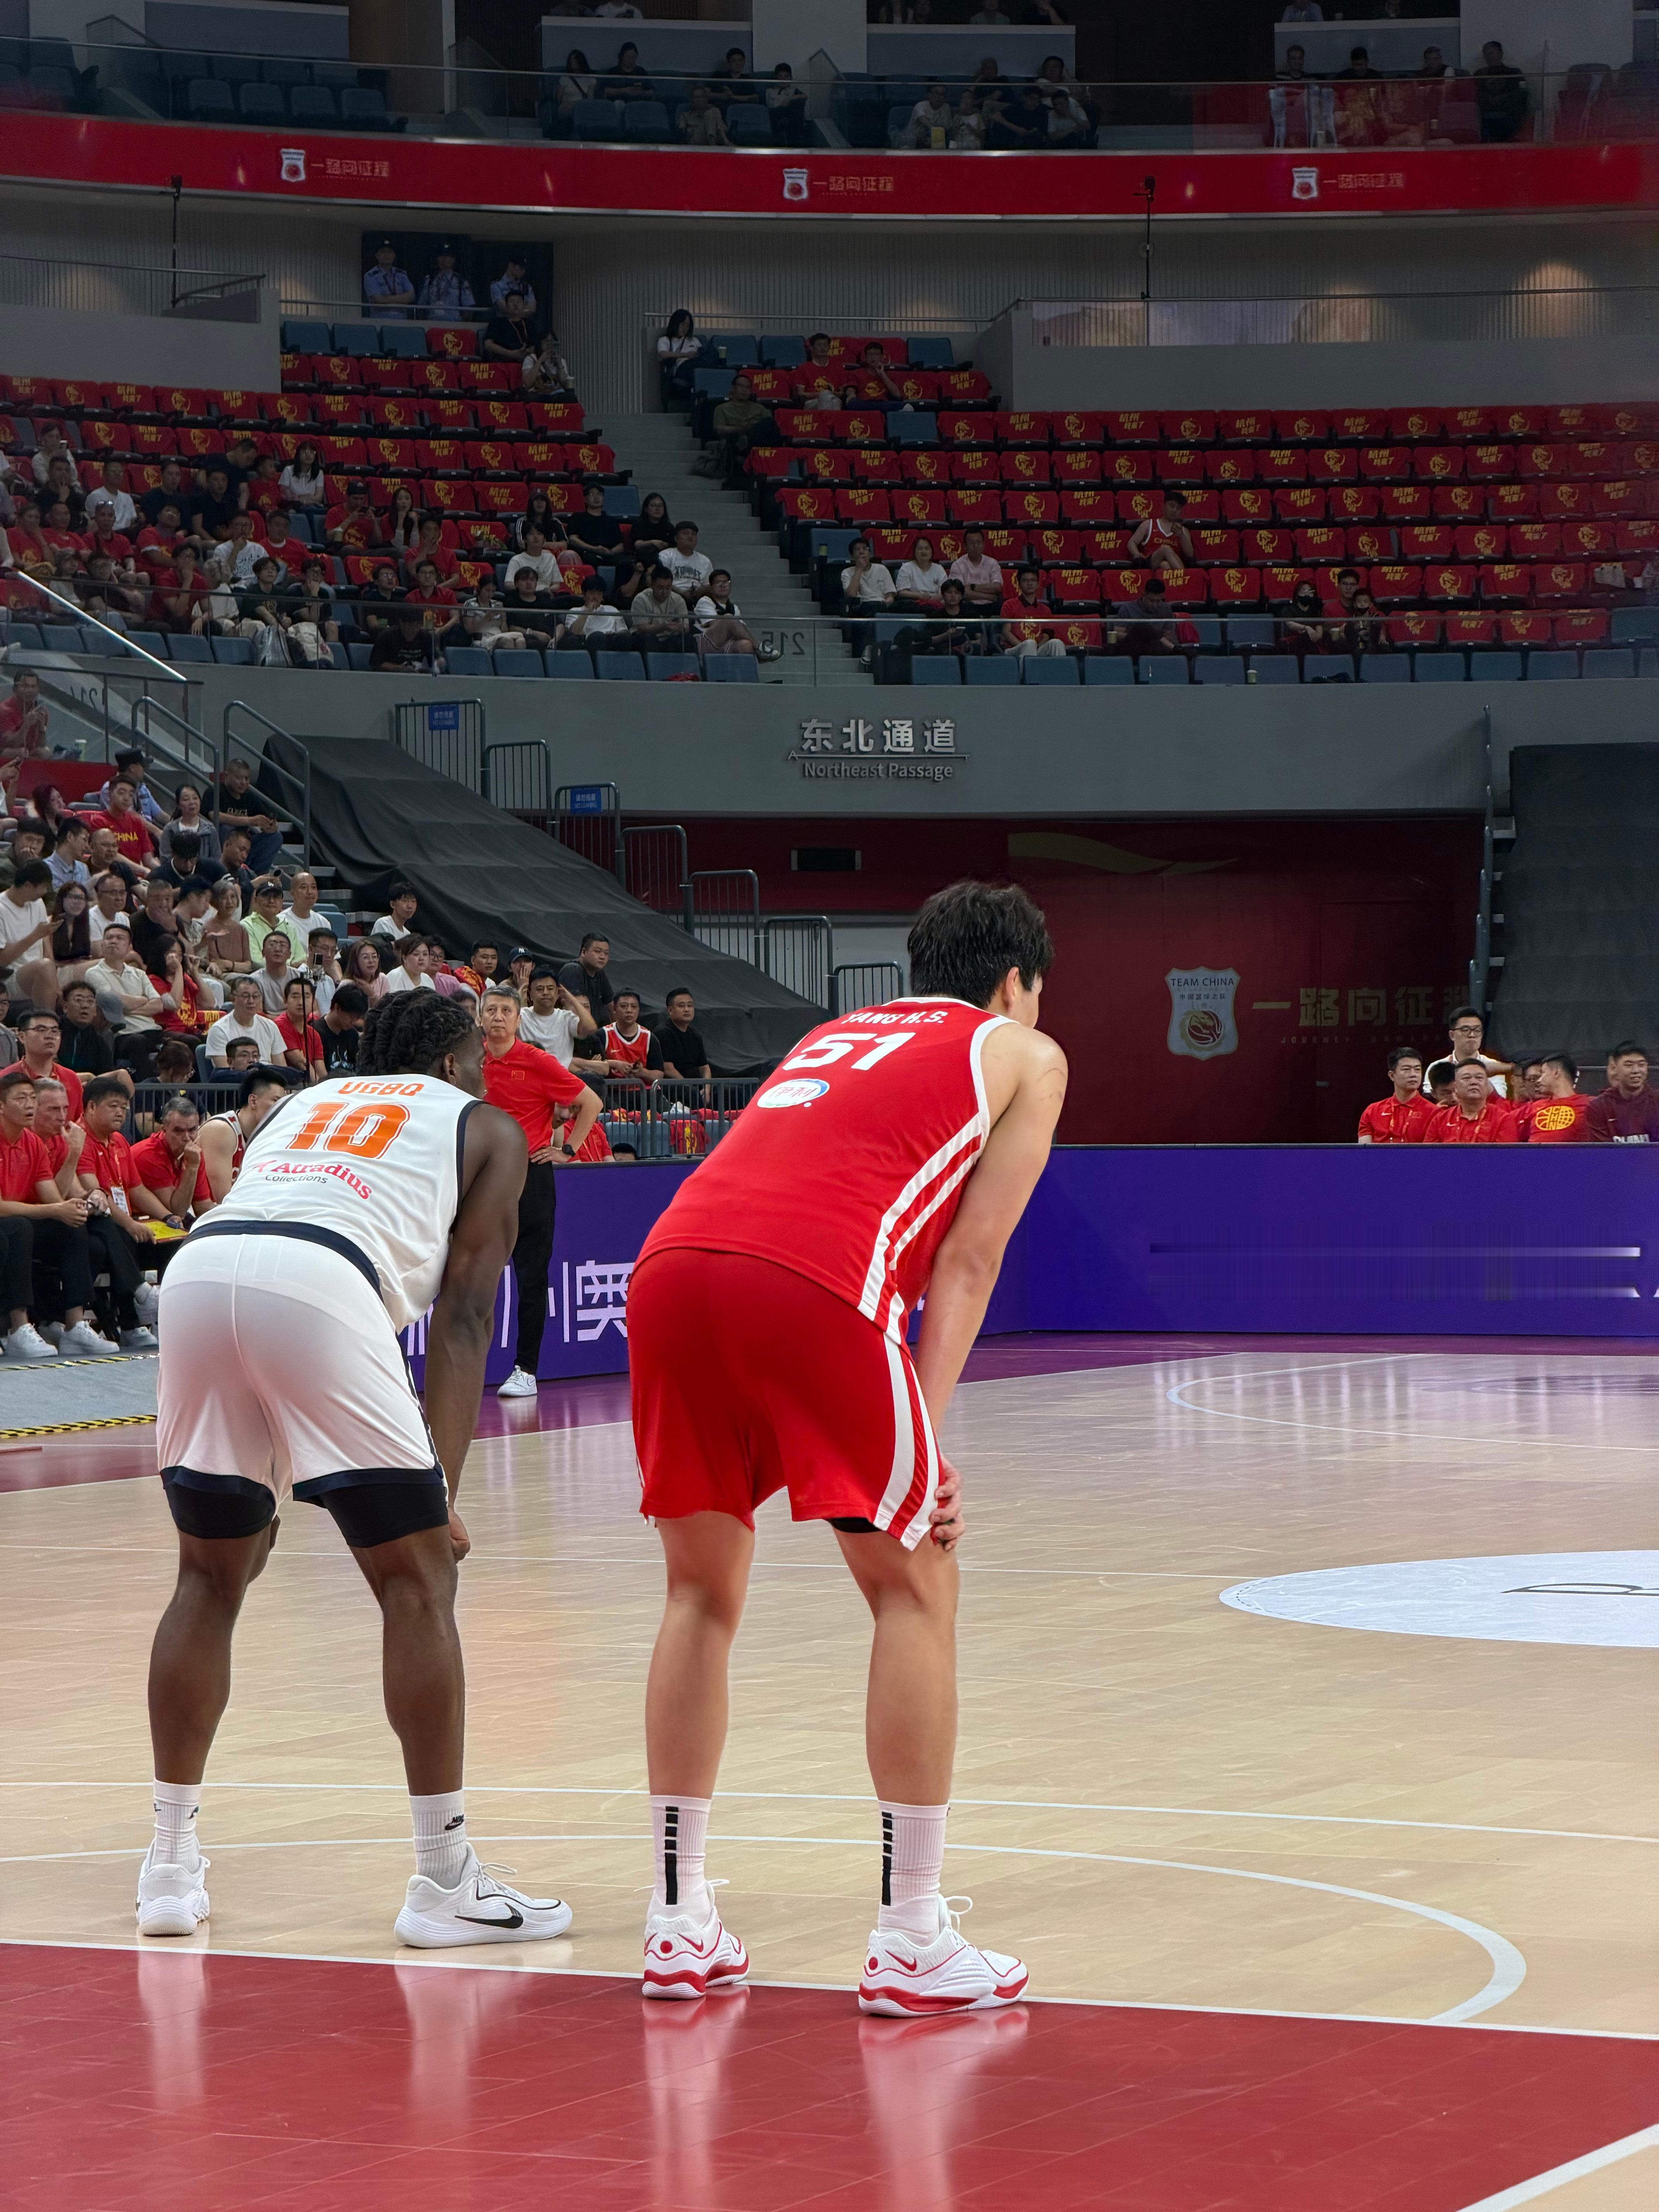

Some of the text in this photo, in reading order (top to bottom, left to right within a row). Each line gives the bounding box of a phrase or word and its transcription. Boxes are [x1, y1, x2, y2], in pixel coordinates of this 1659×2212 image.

[800, 718, 956, 753] 东北通道
[804, 762, 953, 781] Northeast Passage
[1170, 978, 1235, 986] TEAM CHINA
[900, 1011, 948, 1024] H.S.
[783, 1032, 916, 1071] 51
[768, 1087, 818, 1098] 伊利
[286, 1102, 411, 1159] 10
[265, 1175, 328, 1183] Collections
[271, 1163, 372, 1199] Atradius
